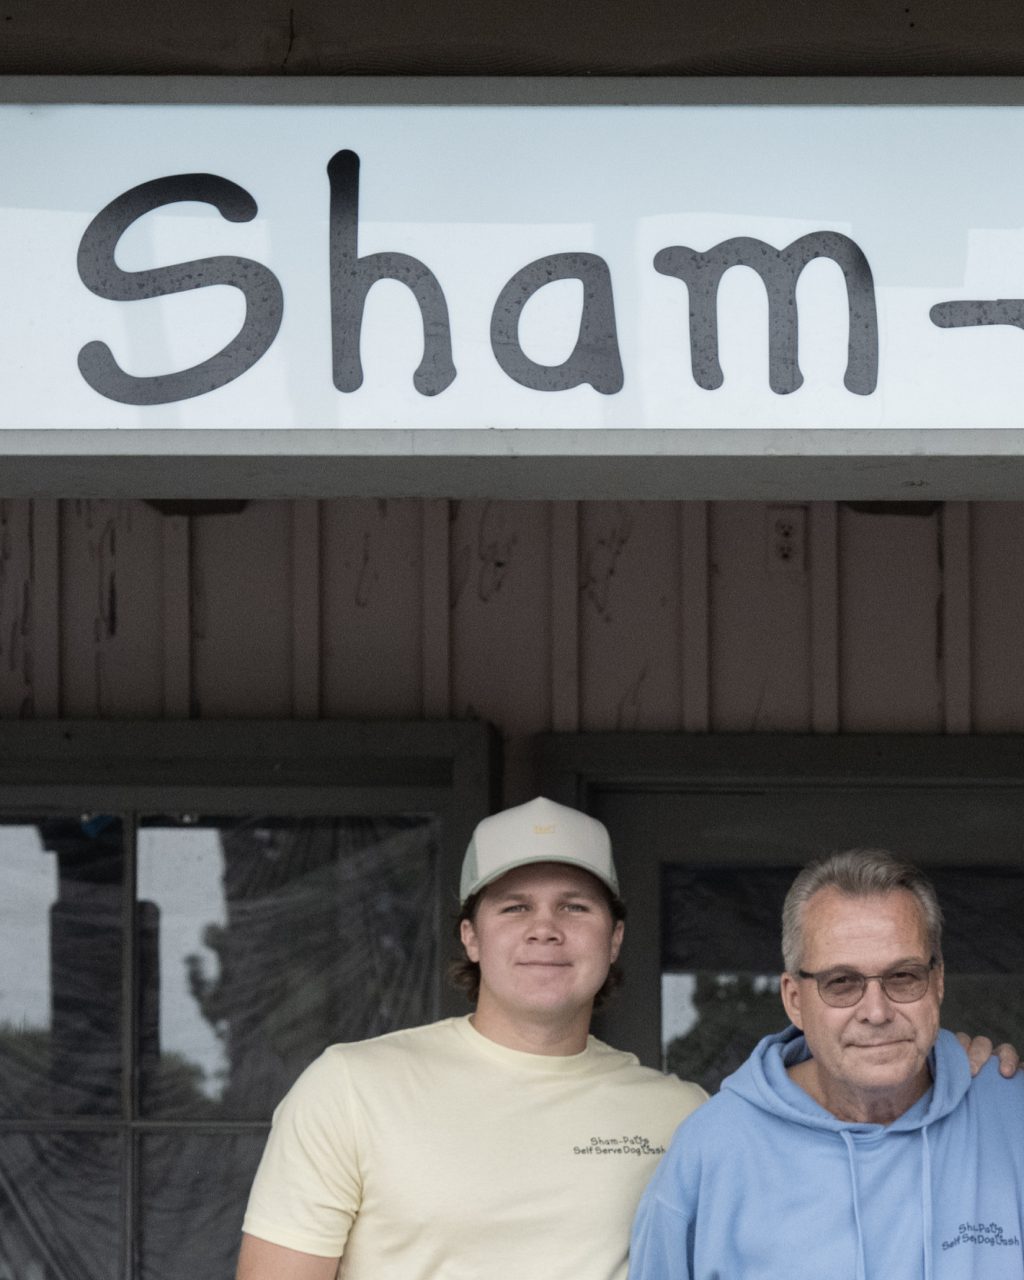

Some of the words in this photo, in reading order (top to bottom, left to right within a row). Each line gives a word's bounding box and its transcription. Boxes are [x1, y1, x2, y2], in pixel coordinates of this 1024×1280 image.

[590, 1135, 650, 1146] Sham-Paws
[573, 1146, 593, 1155] Self
[594, 1146, 622, 1155] Serve
[623, 1145, 641, 1156] Dog
[977, 1234, 995, 1246] Dog
